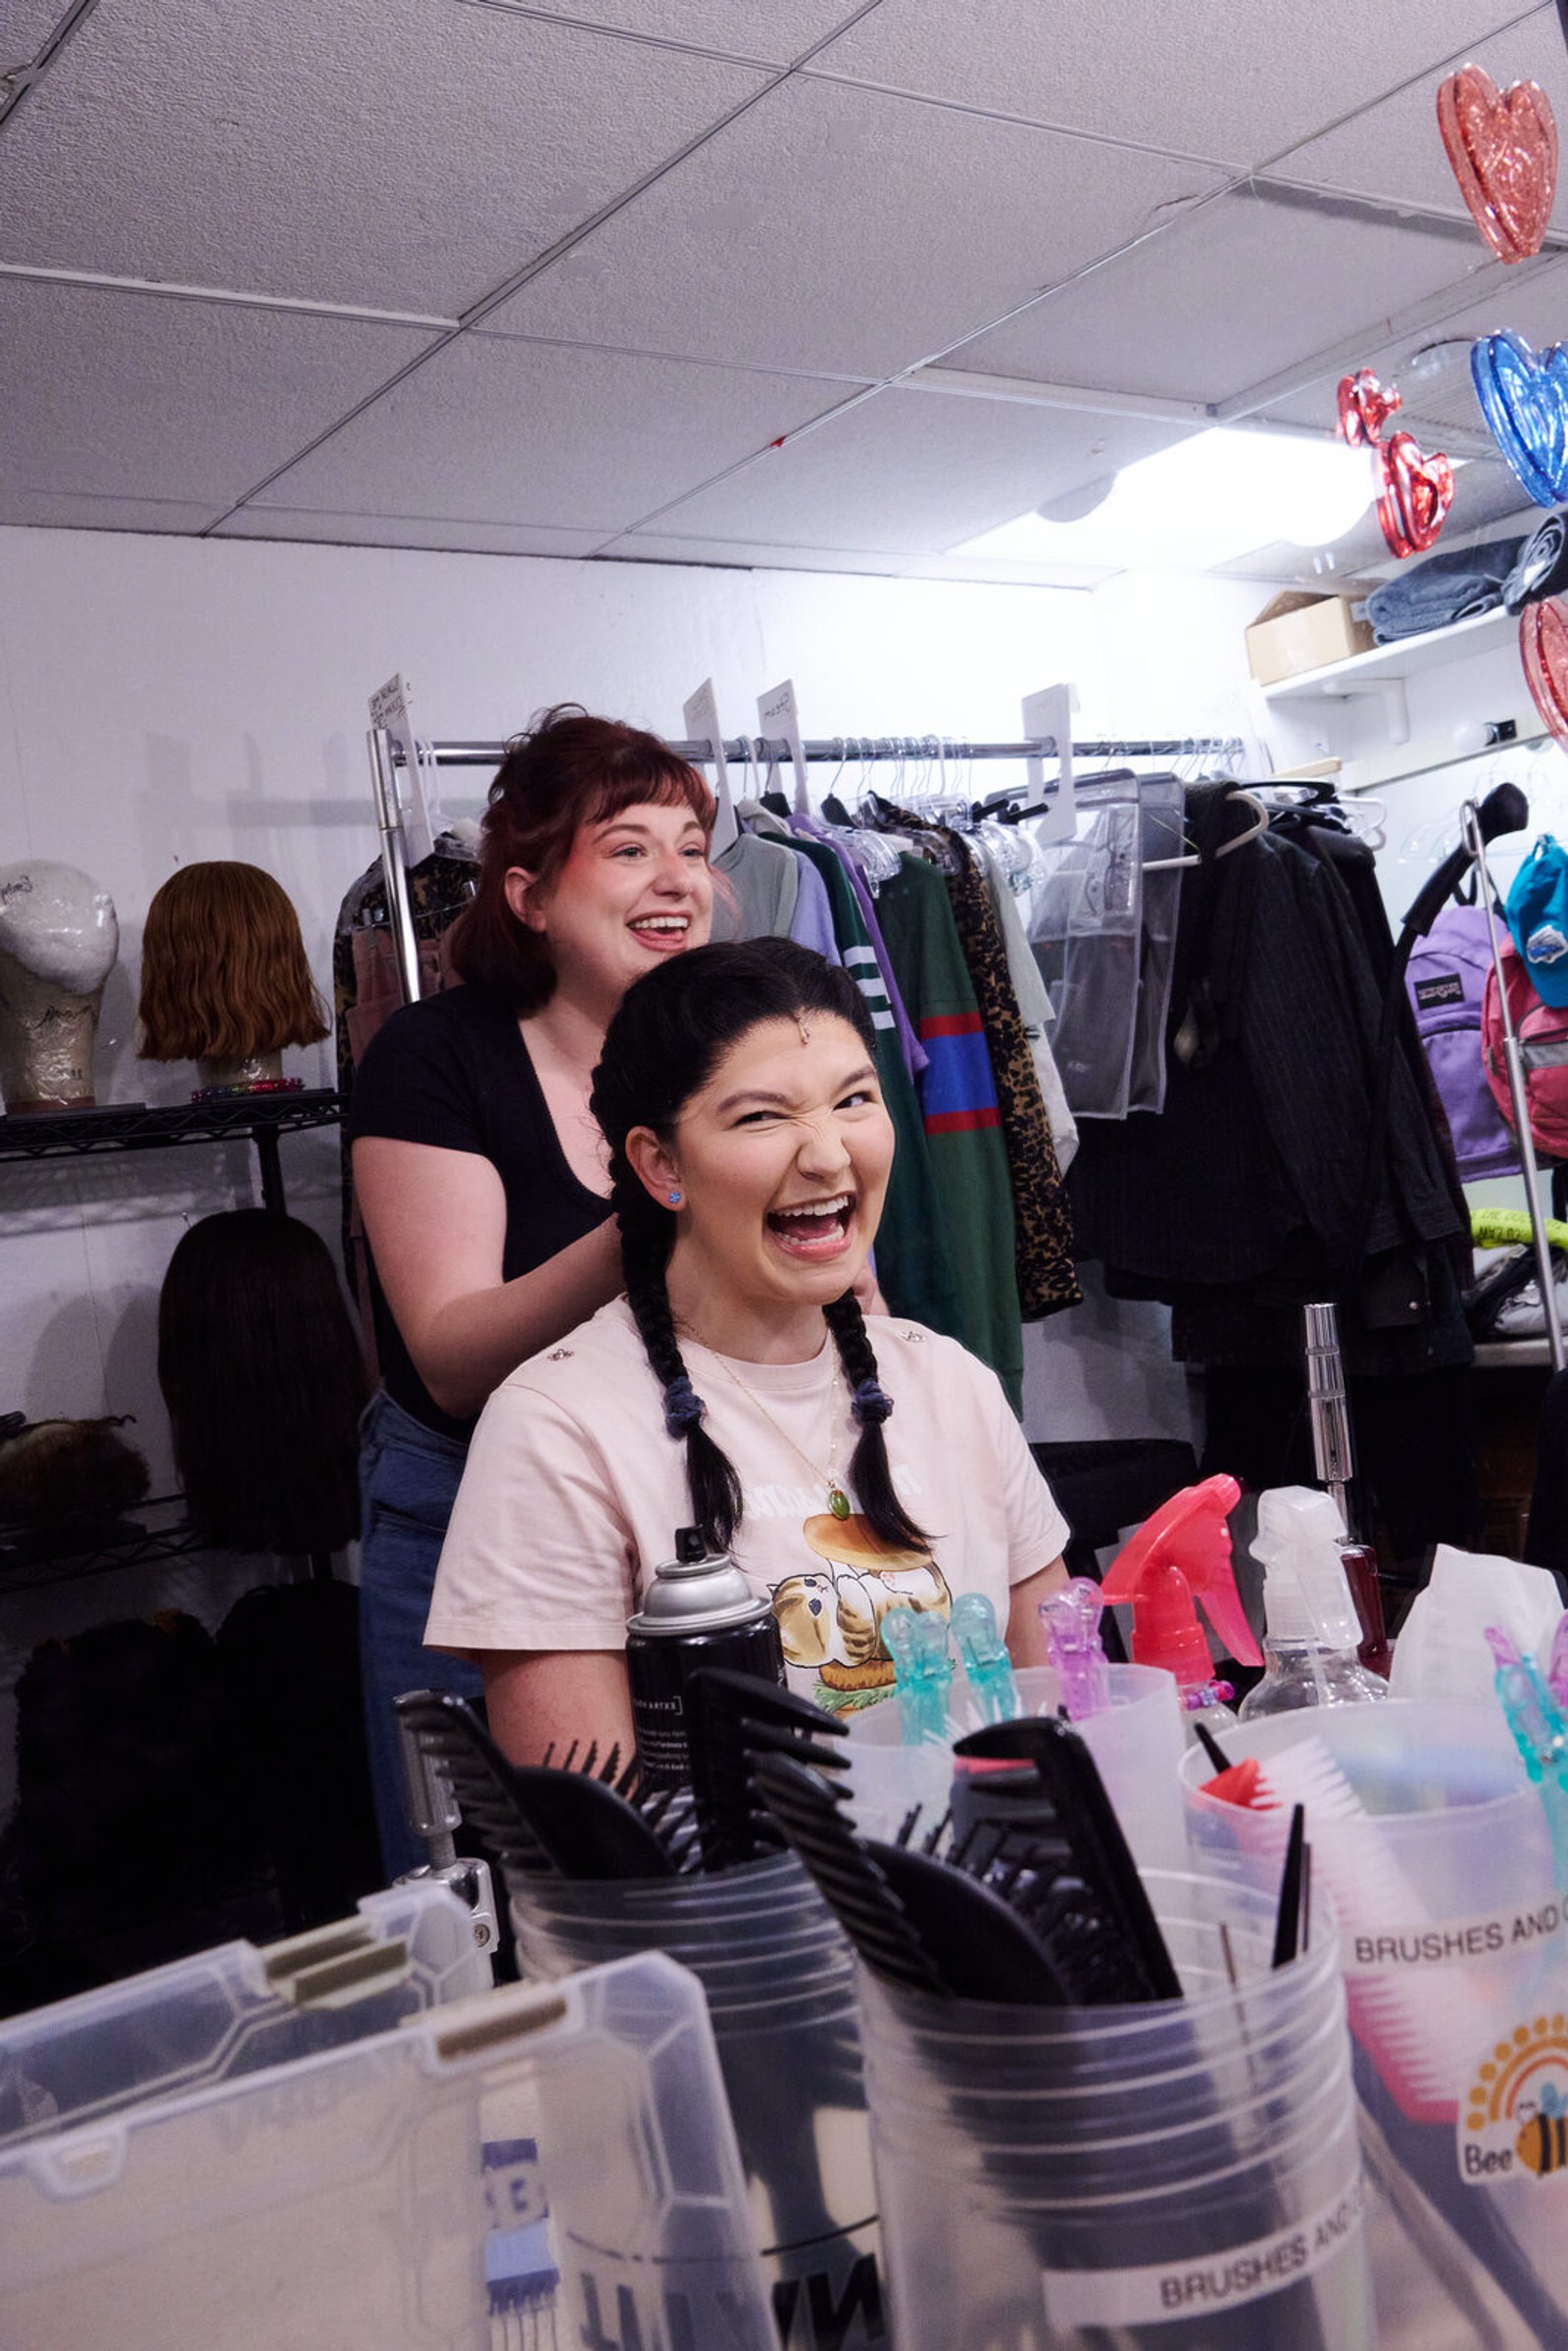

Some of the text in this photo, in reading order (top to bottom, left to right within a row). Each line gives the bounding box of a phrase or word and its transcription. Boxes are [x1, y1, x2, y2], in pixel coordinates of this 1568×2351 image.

[1355, 1922, 1504, 1963] BRUSHES
[1510, 1903, 1560, 1945] AND
[1464, 2143, 1513, 2177] Bee
[1158, 2232, 1308, 2310] BRUSHES
